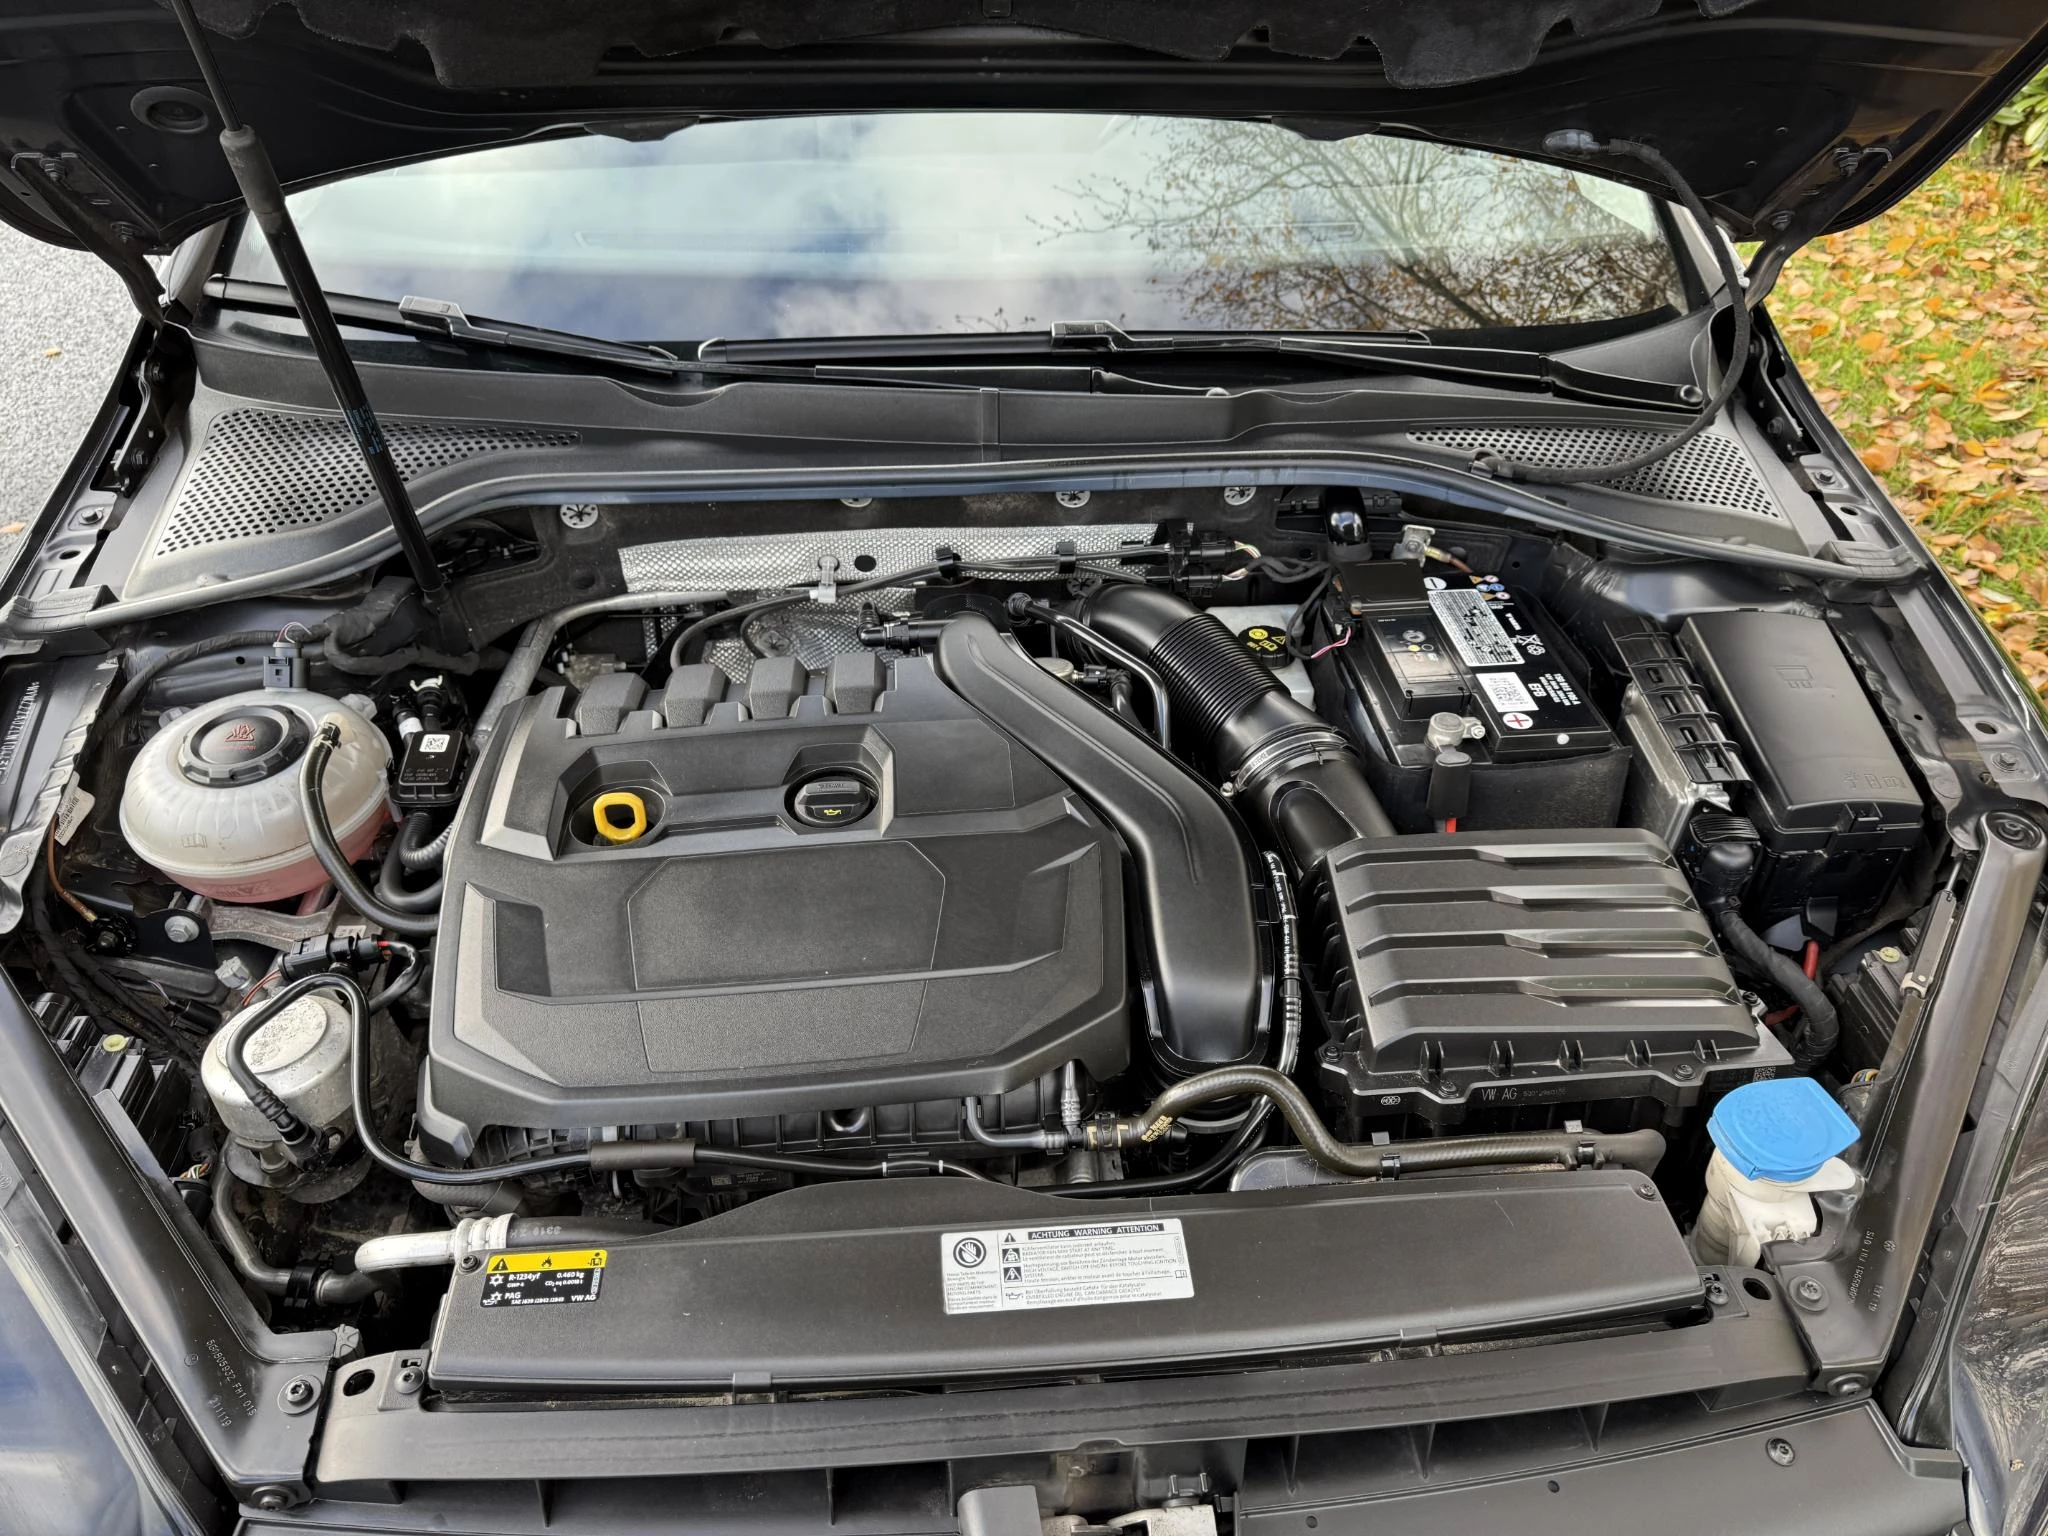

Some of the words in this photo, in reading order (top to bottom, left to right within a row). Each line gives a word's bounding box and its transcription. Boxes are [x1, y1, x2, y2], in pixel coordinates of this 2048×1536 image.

[1528, 683, 1547, 697] EFB
[1481, 1088, 1497, 1100] VW
[1501, 1087, 1517, 1100] AG
[1032, 1230, 1069, 1239] ACHTUNG
[1074, 1228, 1112, 1236] WARNING
[1116, 1225, 1159, 1233] ATTENTION
[509, 1273, 541, 1282] R-1234yf
[576, 1271, 585, 1279] kg
